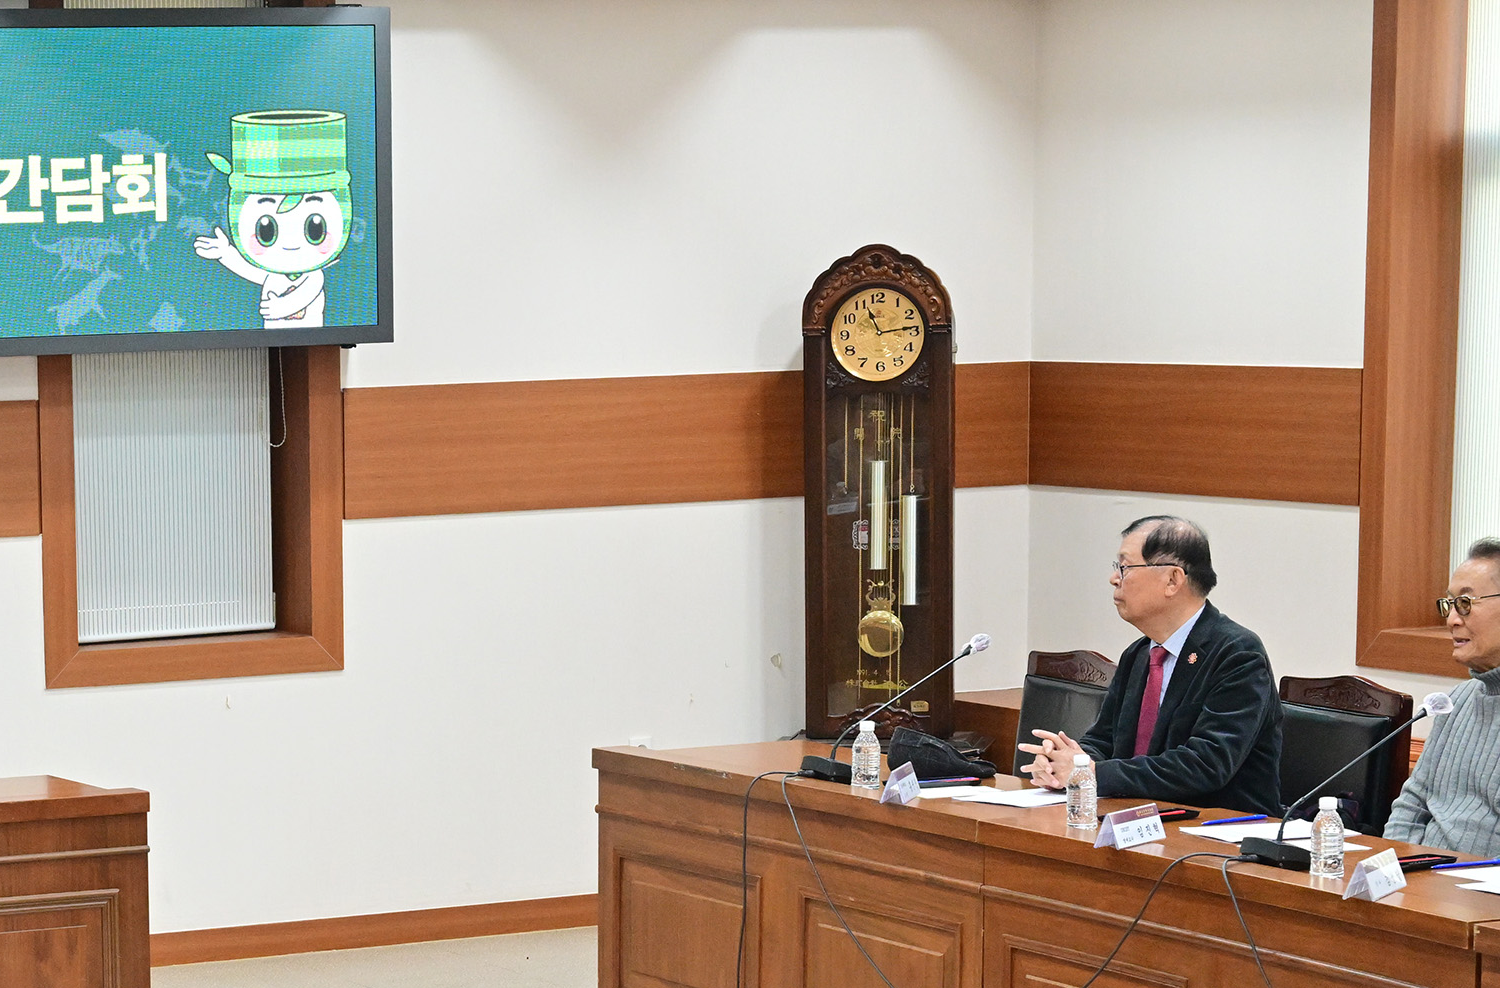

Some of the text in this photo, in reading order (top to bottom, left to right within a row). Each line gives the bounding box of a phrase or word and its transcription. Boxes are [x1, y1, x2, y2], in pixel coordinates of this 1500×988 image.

[871, 292, 886, 304] 12
[895, 297, 900, 307] 1
[855, 299, 867, 311] 11
[843, 313, 856, 325] 10
[905, 309, 915, 320] 2
[840, 330, 850, 341] 9
[909, 325, 920, 337] 3
[844, 345, 856, 356] 8
[904, 342, 914, 352] 4
[857, 357, 869, 368] 7
[875, 361, 886, 372] 6
[893, 355, 904, 367] 5
